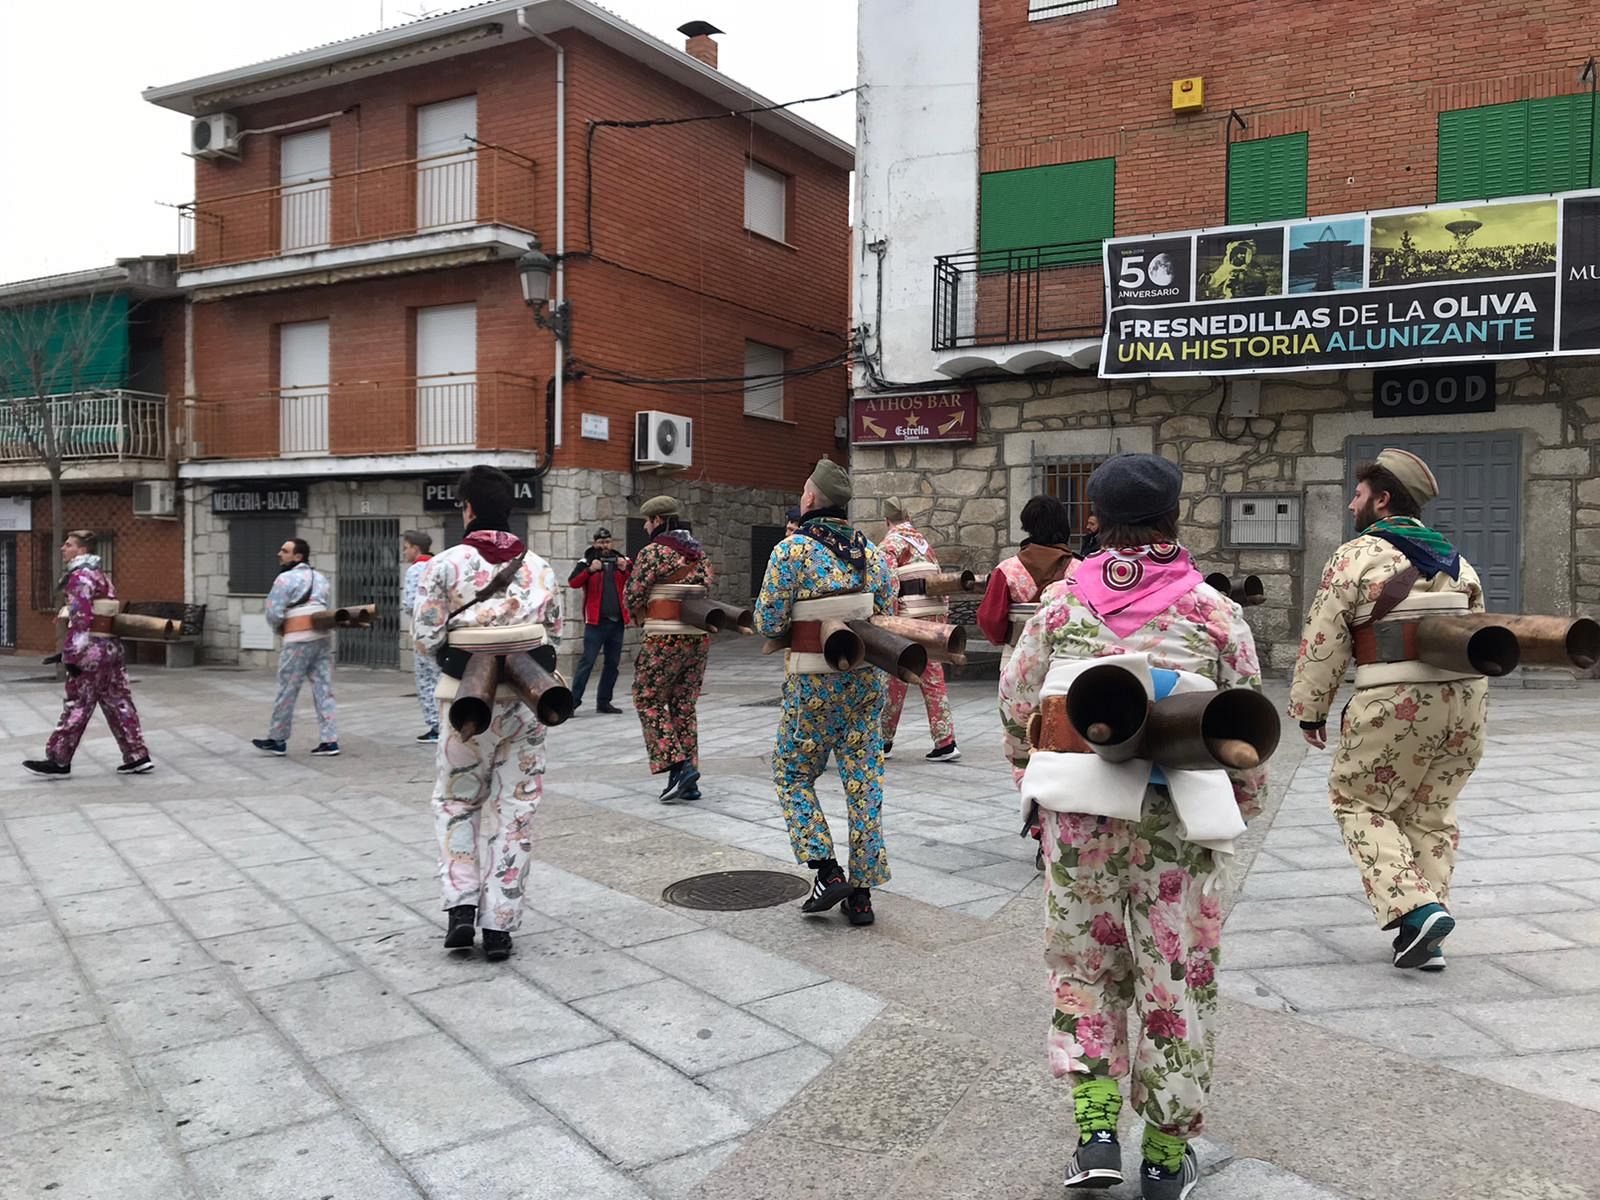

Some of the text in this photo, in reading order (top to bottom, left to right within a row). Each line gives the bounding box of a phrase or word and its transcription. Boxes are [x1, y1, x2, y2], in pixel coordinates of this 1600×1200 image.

[1118, 287, 1180, 299] ANIVERSARIO
[1119, 292, 1537, 340] FRESNEDILLAS DE LA OLIVA
[1118, 317, 1536, 363] UNA HISTORIA ALUNIZANTE
[865, 394, 962, 412] ATHOS BAR
[1380, 375, 1488, 407] GOOD
[895, 425, 929, 436] Estrella
